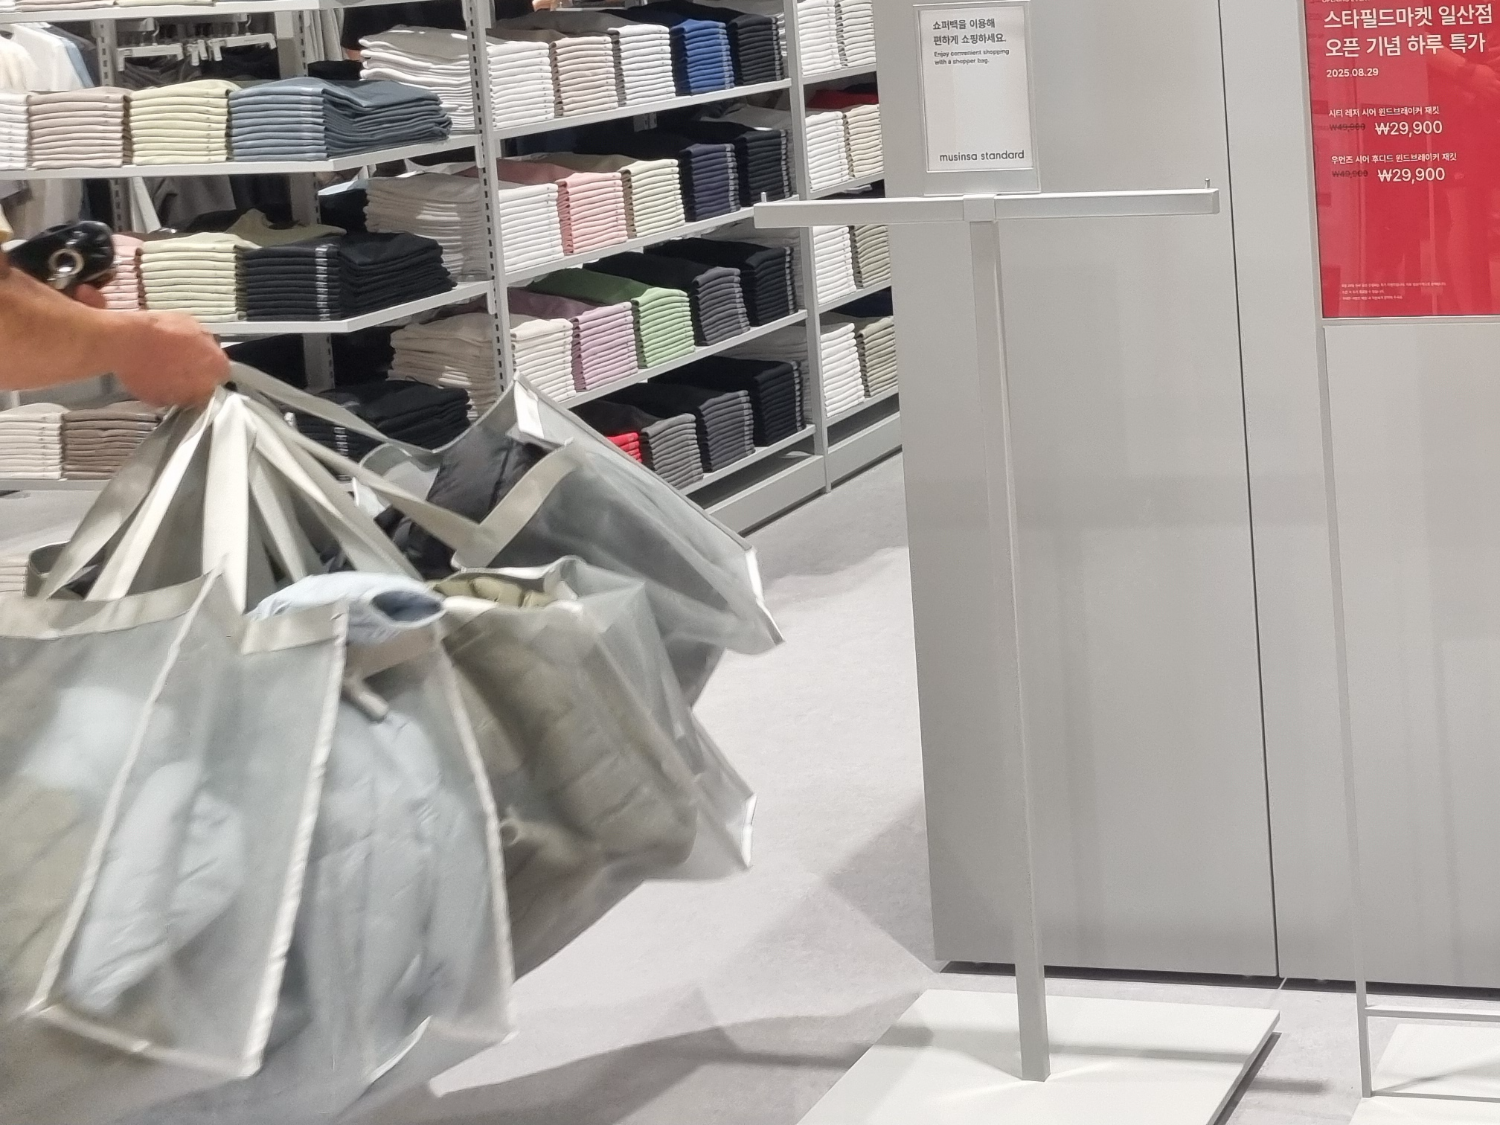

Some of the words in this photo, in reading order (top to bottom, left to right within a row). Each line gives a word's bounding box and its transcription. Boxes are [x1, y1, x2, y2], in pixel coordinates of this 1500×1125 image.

[1323, 5, 1433, 29] 스타필드마켓
[1438, 3, 1493, 26] 일산점
[932, 19, 967, 31] 쇼퍼백을
[969, 18, 995, 29] 이용해
[933, 34, 959, 46] 편하게
[961, 33, 1007, 45] 쇼핑하세요.
[1325, 38, 1361, 58] 오픈
[1366, 36, 1401, 56] 기념
[1406, 34, 1444, 55] 하루
[1449, 32, 1486, 54] 특가
[983, 48, 1010, 56] shopping
[1326, 68, 1379, 78] 2025.08.29
[1378, 106, 1423, 116] 윈드브레이커
[1374, 120, 1443, 138] ₩29,900
[939, 152, 978, 162] musinsa
[980, 150, 1025, 161] standard
[1331, 155, 1353, 165] 우먼즈
[1395, 153, 1440, 162] 윈드브레이커
[1377, 167, 1446, 185] ₩29,900
